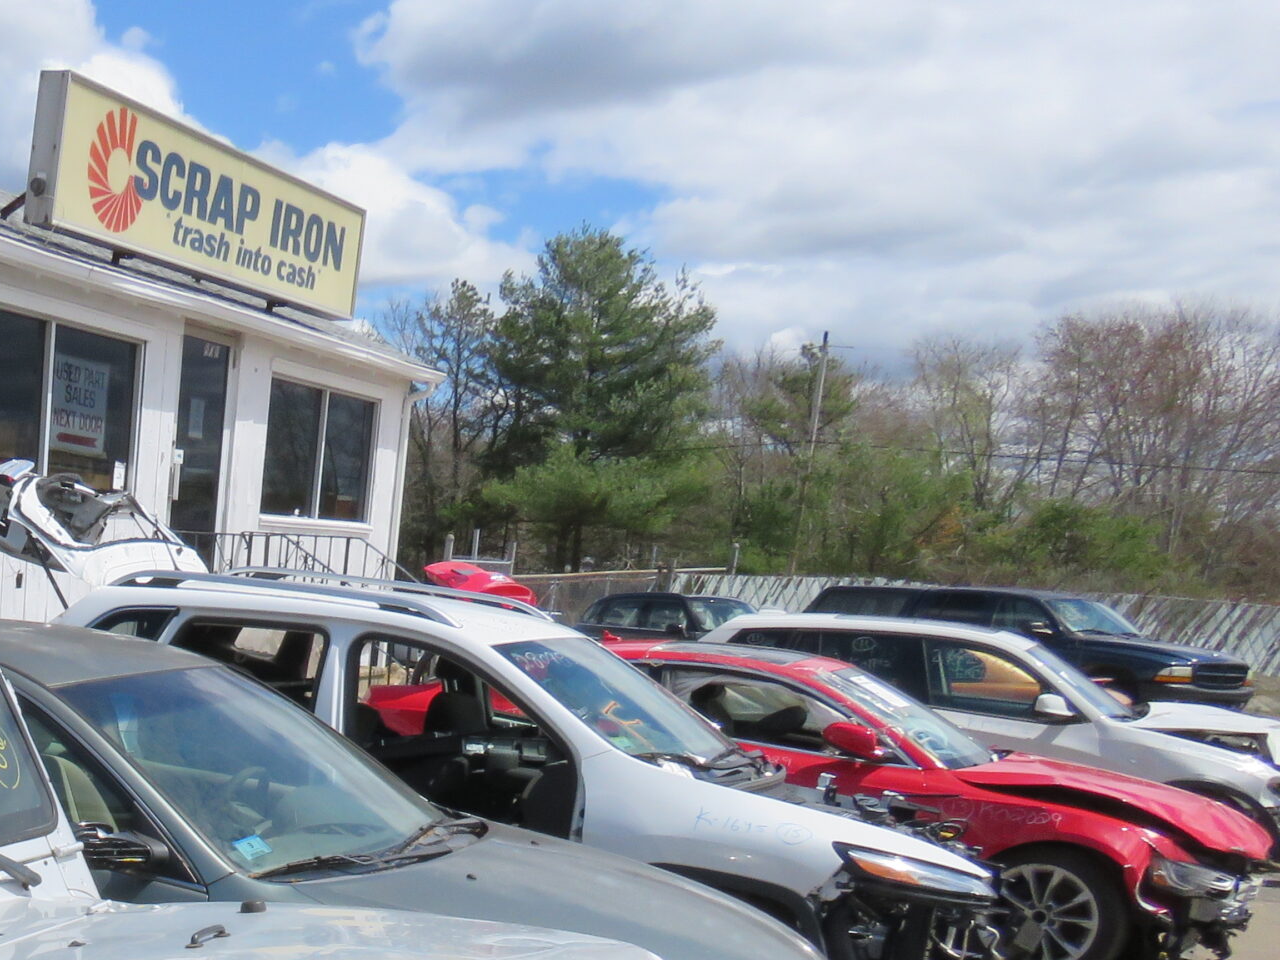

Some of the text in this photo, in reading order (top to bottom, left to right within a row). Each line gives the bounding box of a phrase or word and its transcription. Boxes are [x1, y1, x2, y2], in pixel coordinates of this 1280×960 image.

[134, 140, 346, 271] SCRAP IRON
[173, 216, 316, 290] trash into cash
[56, 362, 81, 383] USED
[65, 384, 96, 409] SALES
[53, 408, 103, 433] NEXT DOOR
